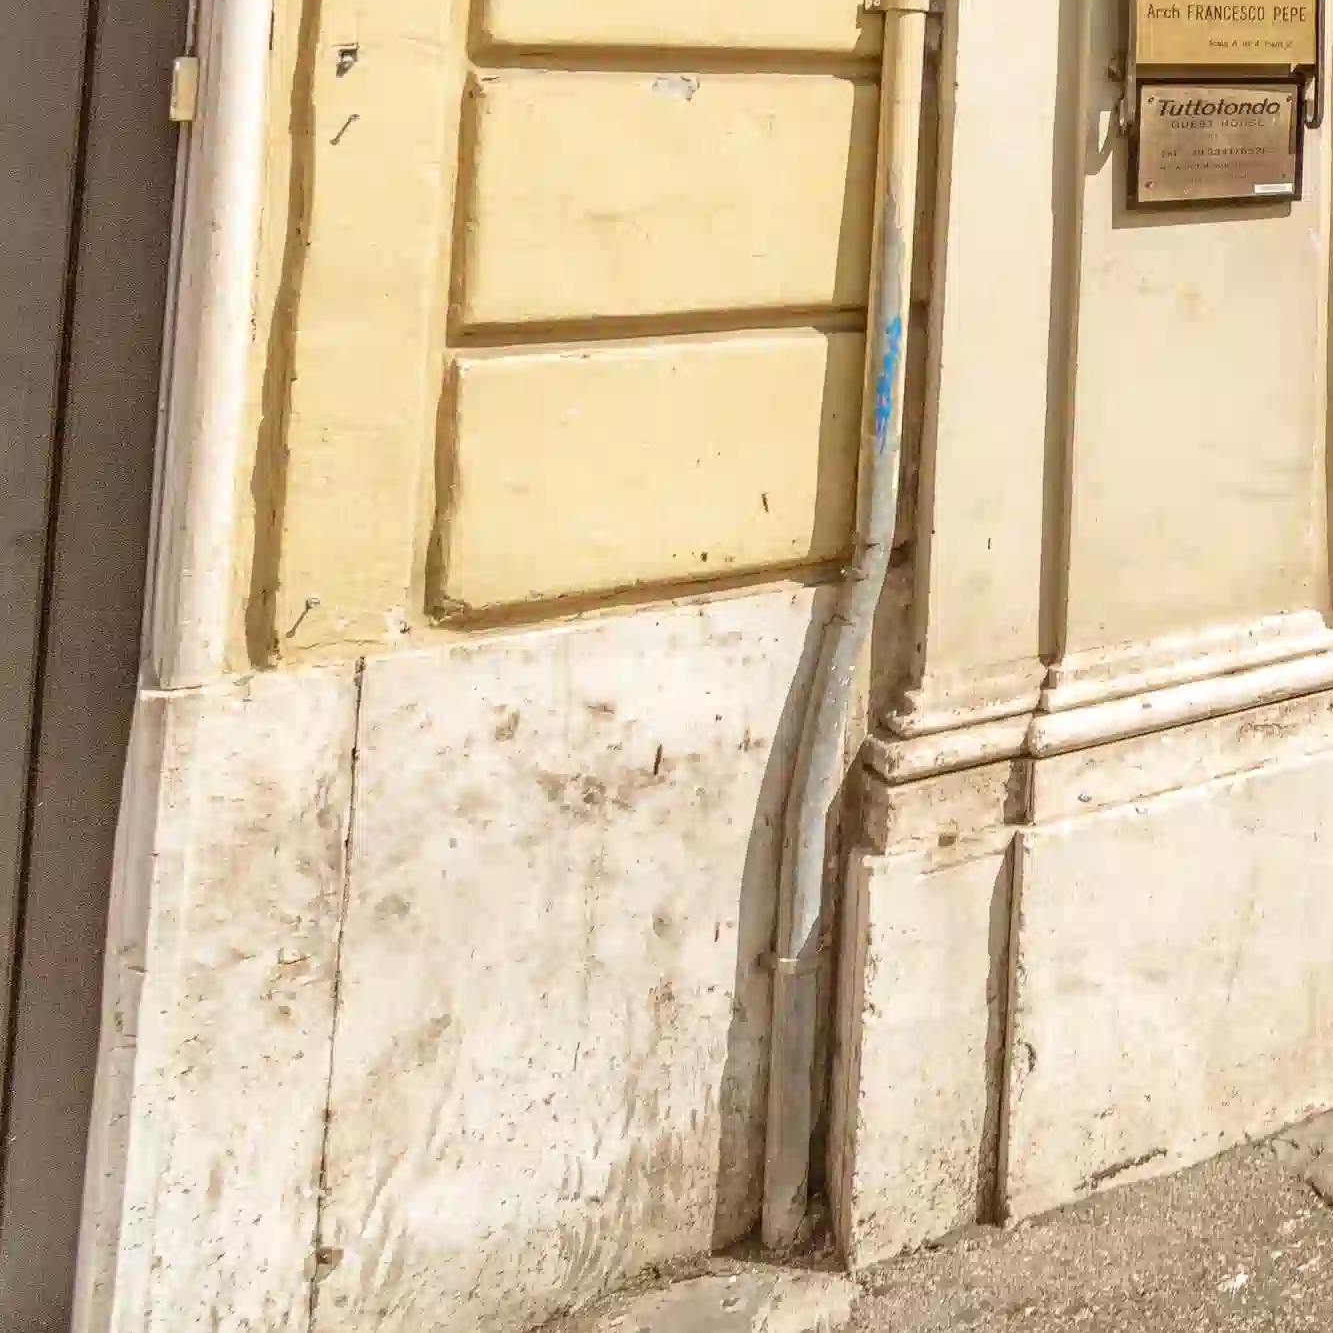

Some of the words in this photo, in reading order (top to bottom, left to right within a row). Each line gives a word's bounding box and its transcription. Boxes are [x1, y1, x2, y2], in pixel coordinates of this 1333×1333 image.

[1187, 4, 1265, 22] FRANCESCO
[1273, 6, 1307, 22] PEPE
[1158, 98, 1281, 116] Tuttotondo
